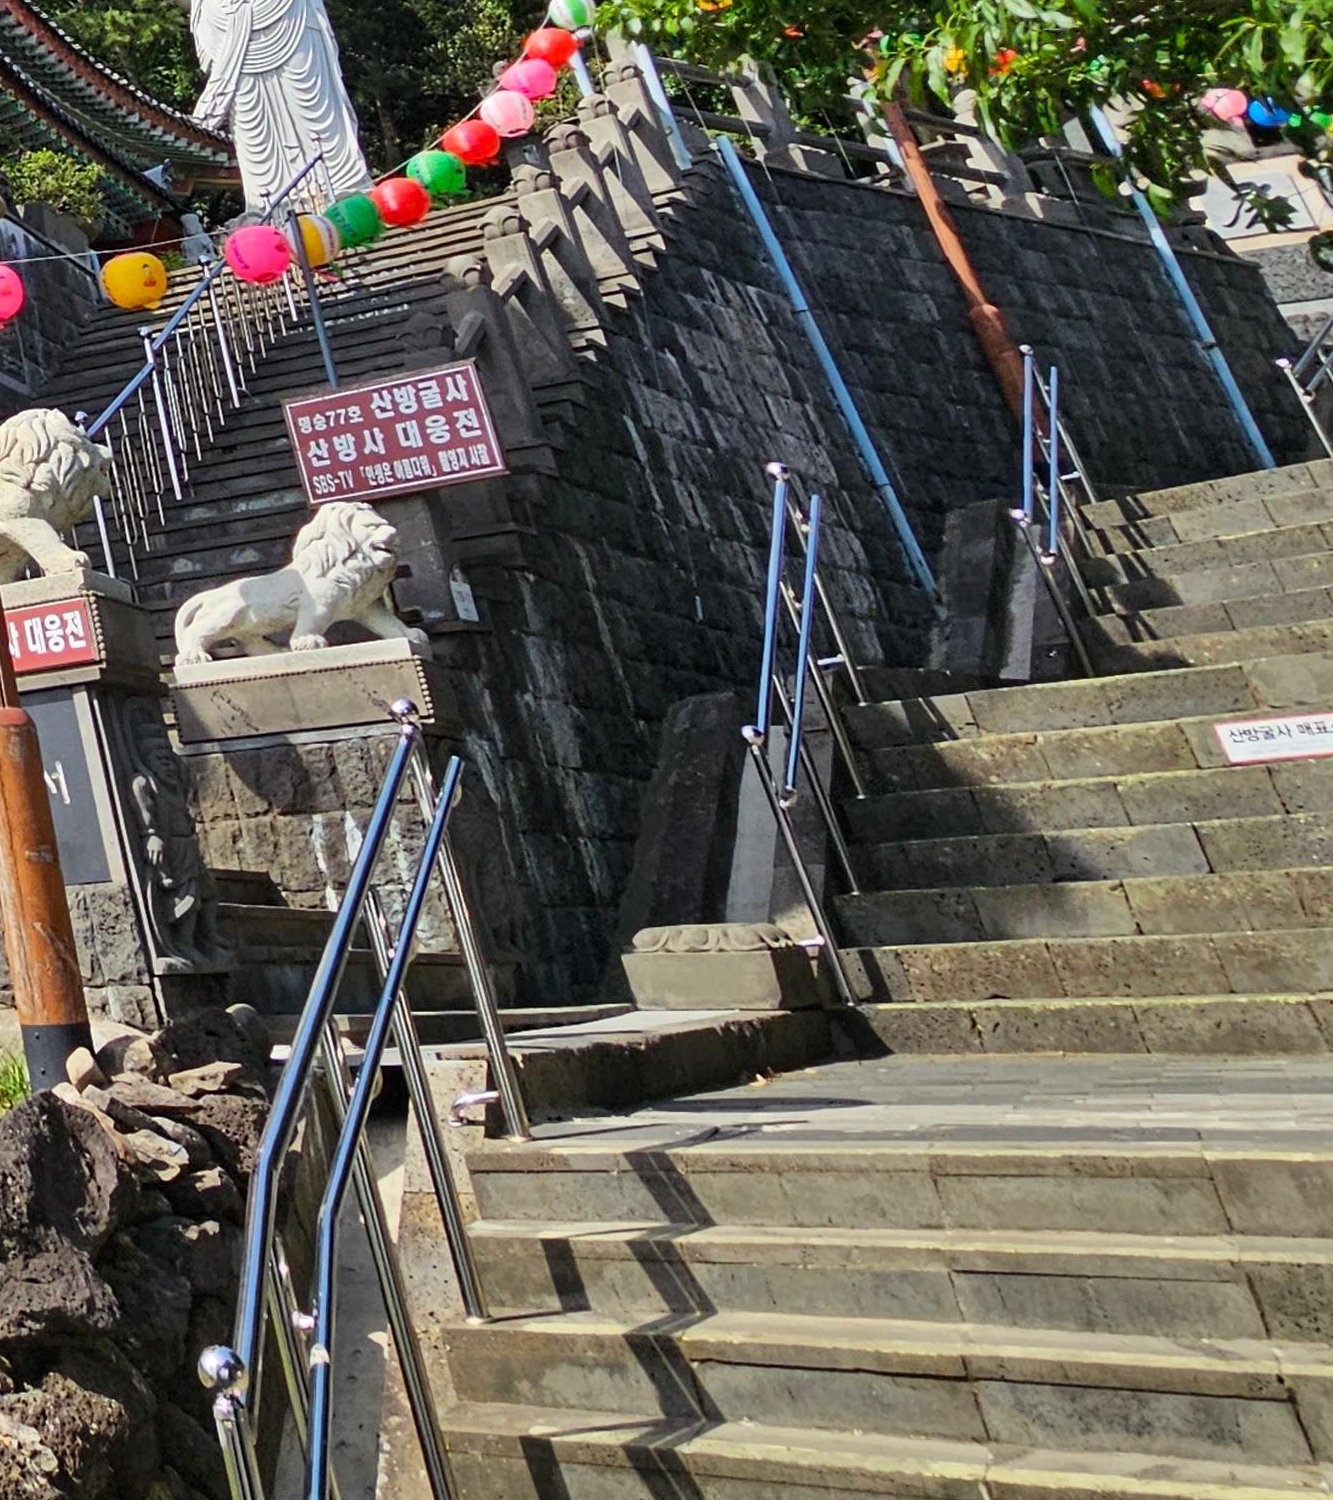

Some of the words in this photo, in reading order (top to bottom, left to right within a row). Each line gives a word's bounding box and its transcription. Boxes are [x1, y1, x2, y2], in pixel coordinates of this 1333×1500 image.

[297, 407, 365, 435] 명승77호
[369, 374, 469, 420] 산방굴사
[307, 426, 387, 468] 산방사
[395, 407, 483, 450] 대웅전
[312, 469, 354, 495] SBS-TV
[23, 609, 87, 656] 대웅전
[1296, 720, 1333, 736] 매표
